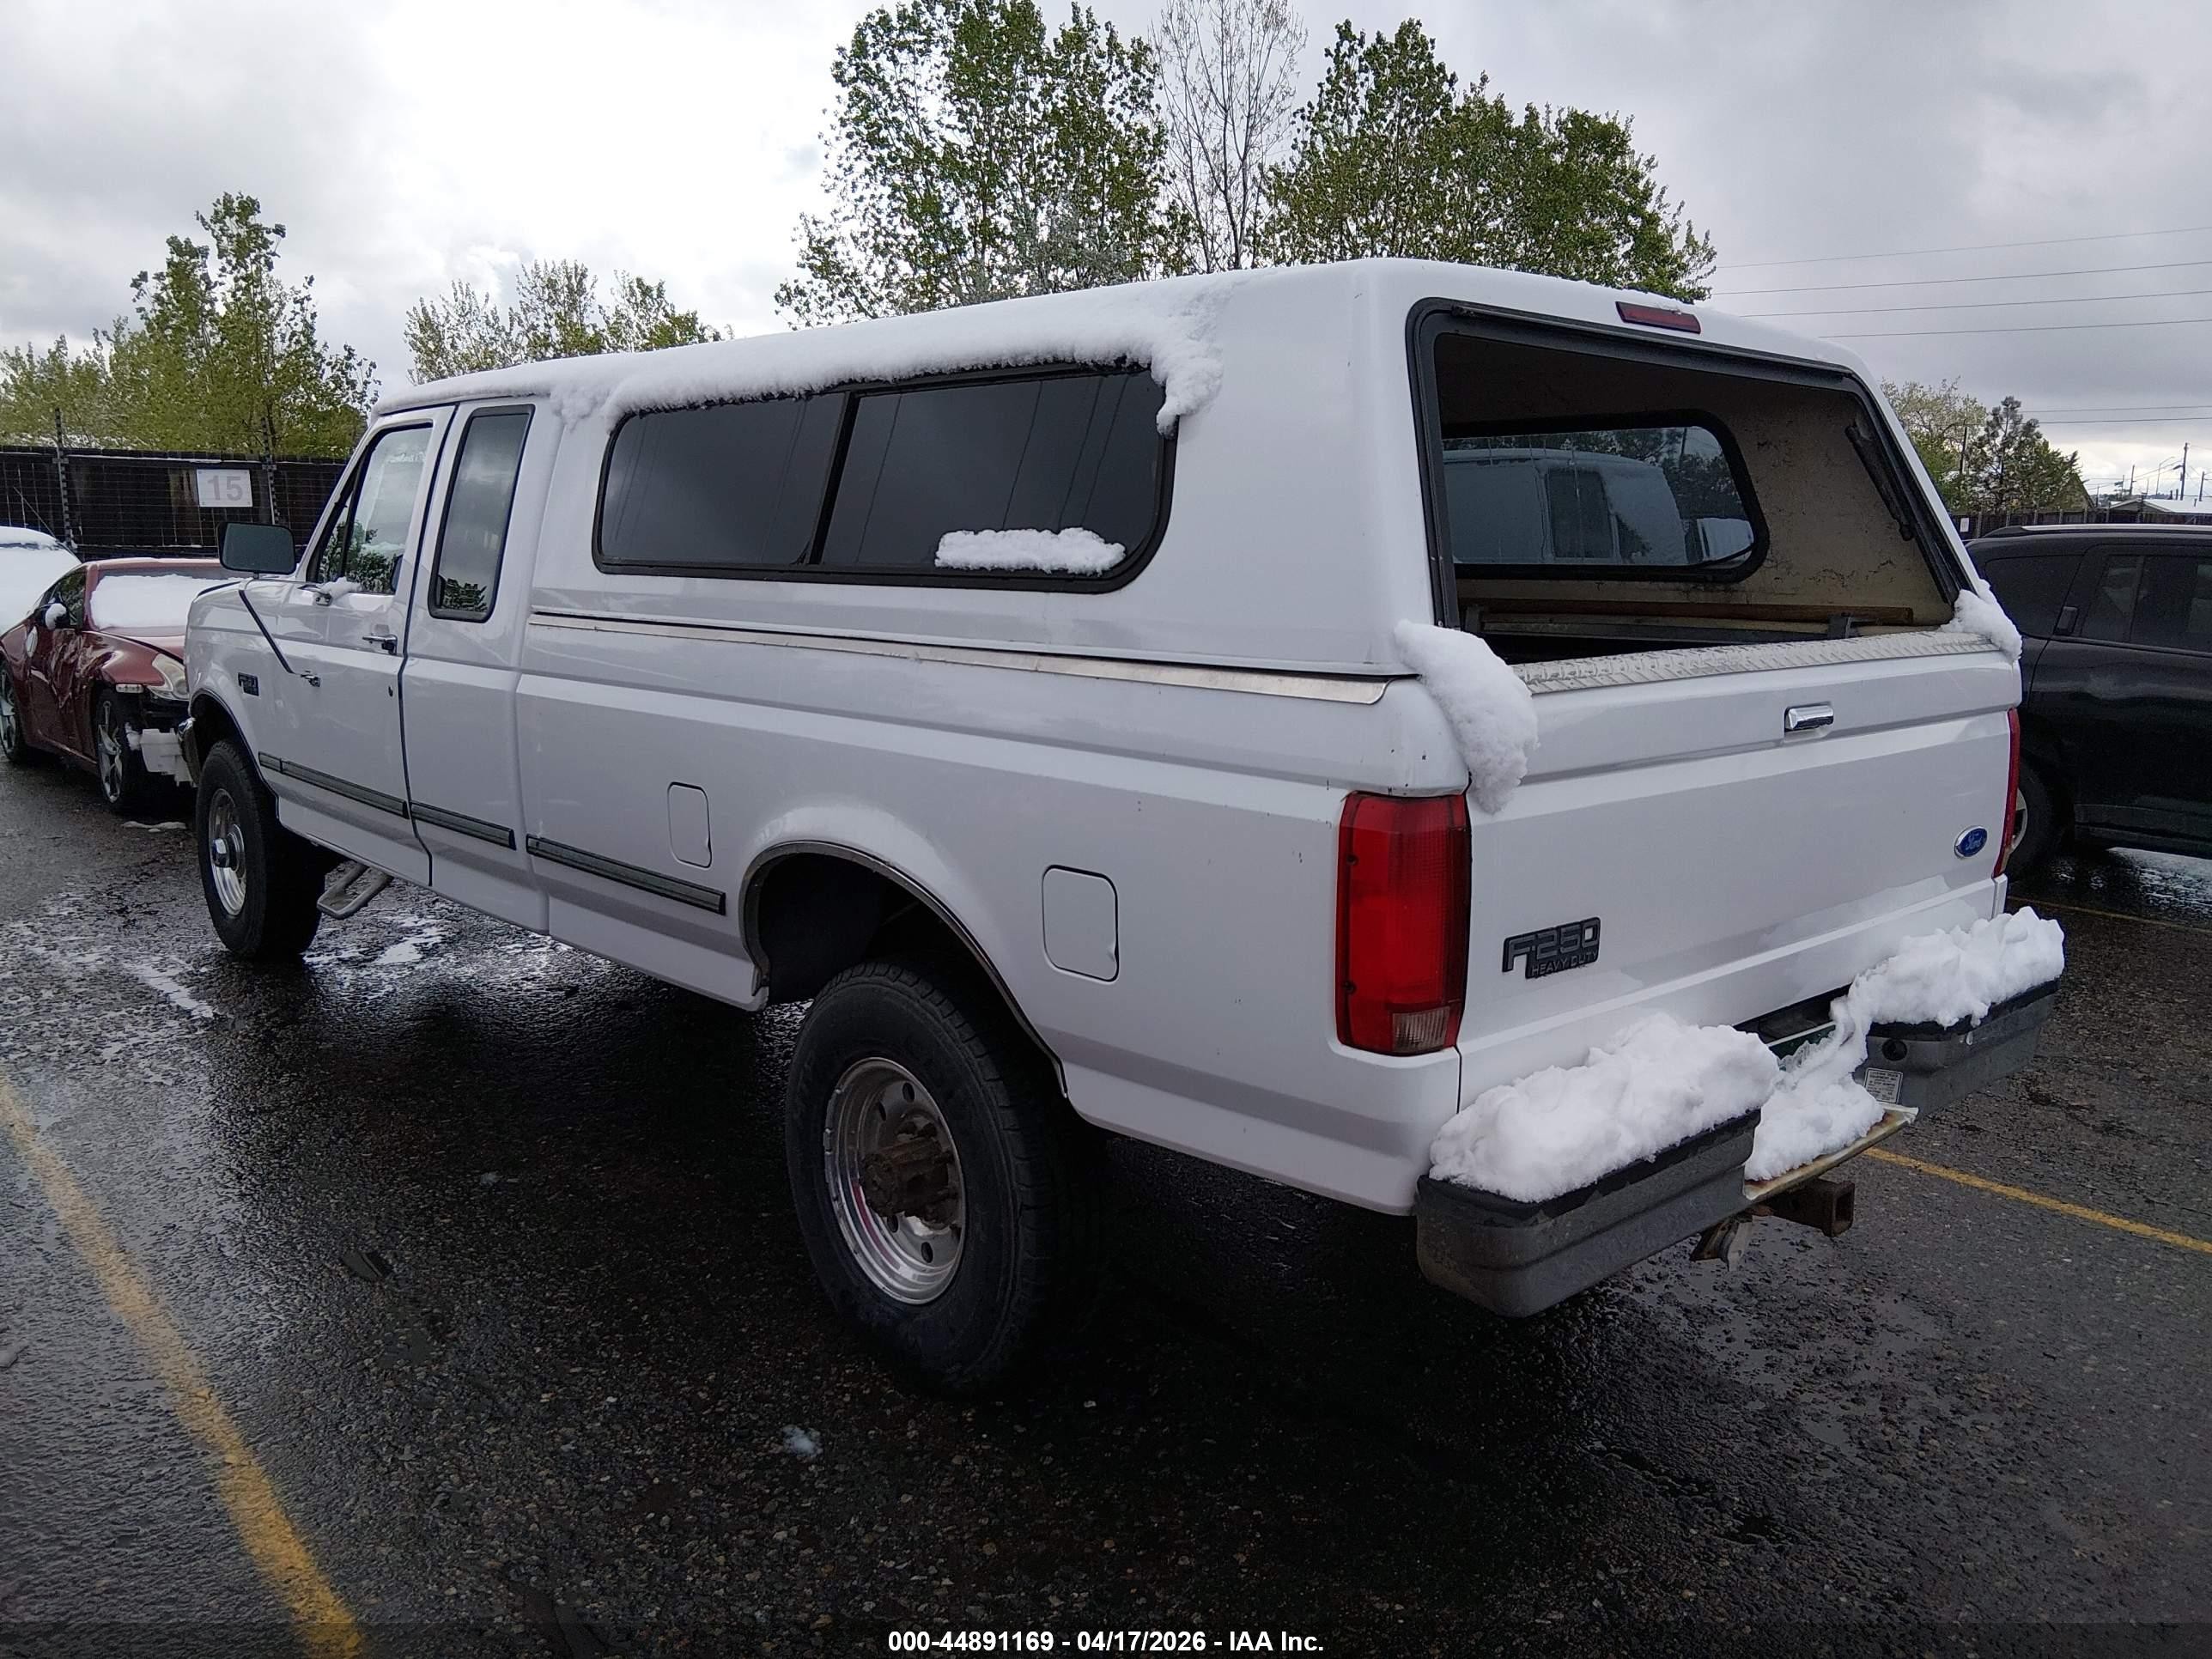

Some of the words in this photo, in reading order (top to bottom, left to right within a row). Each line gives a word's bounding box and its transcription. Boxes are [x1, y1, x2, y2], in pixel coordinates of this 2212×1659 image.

[207, 475, 243, 501] 15
[1531, 957, 1568, 975] HEAVY
[1571, 951, 1597, 967] DUTY
